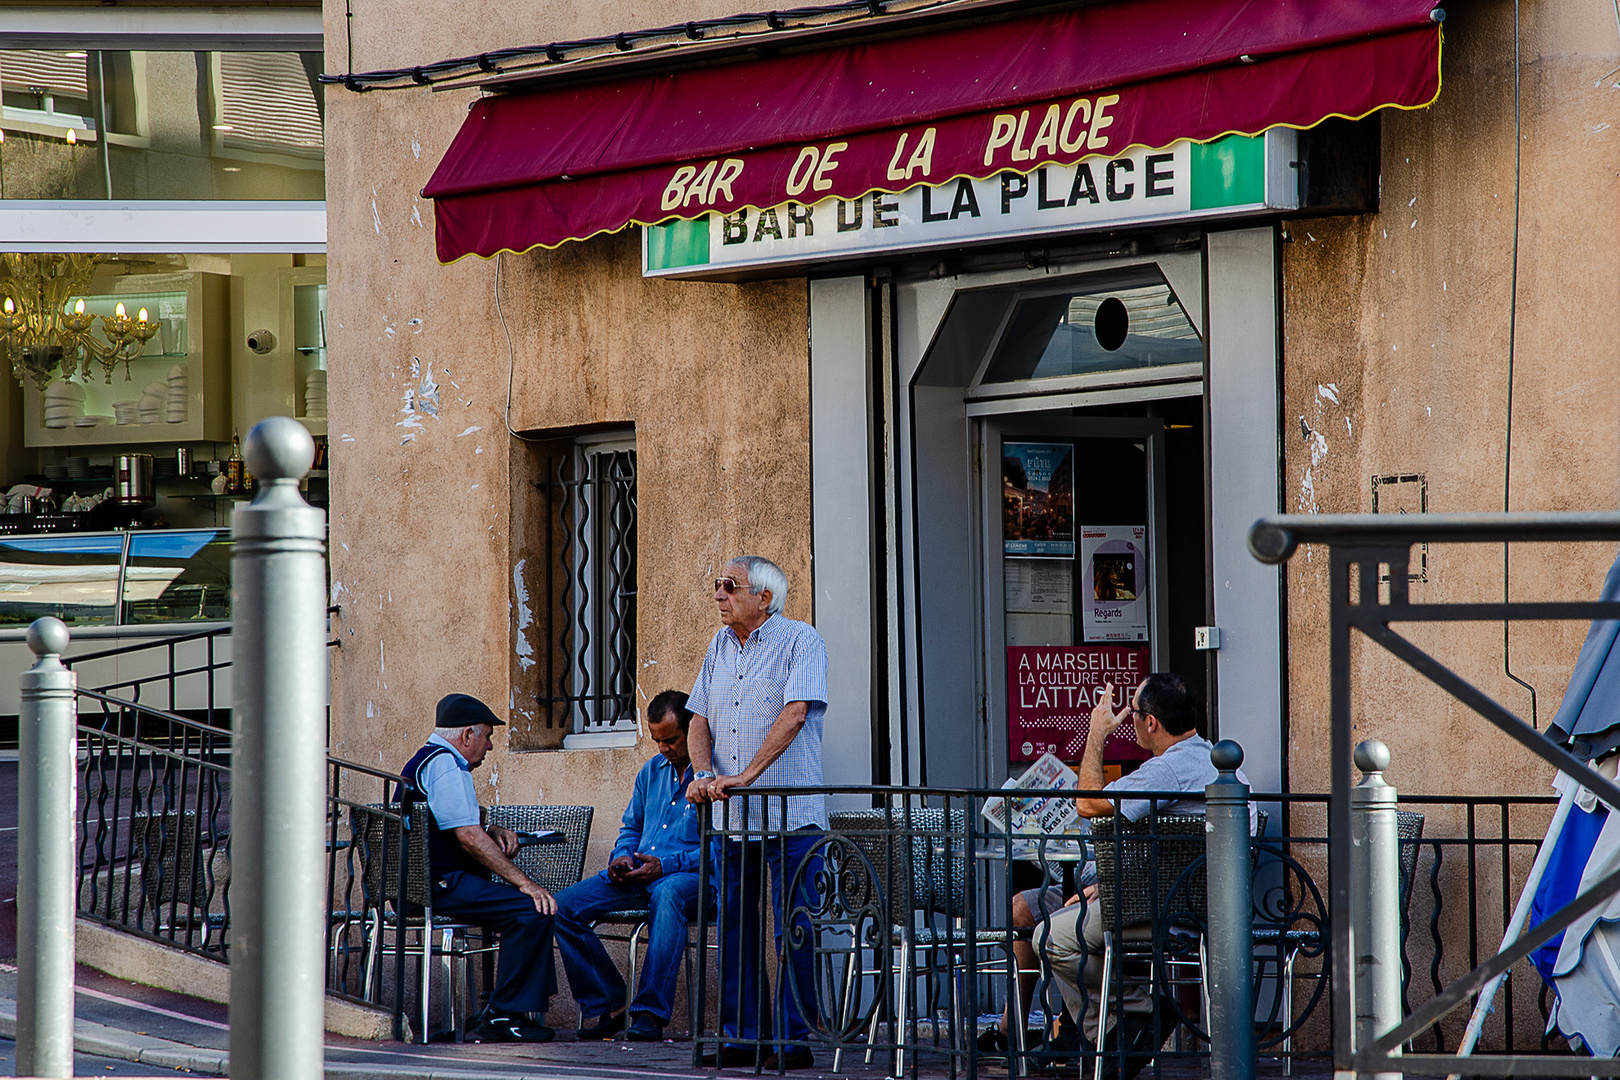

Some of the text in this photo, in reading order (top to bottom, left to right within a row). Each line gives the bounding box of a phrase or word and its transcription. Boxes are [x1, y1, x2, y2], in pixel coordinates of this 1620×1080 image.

[660, 158, 745, 211] BAR
[887, 127, 937, 181] LA
[984, 94, 1120, 167] PLACE
[723, 153, 1175, 246] BAR DE LA PLACE
[1094, 608, 1122, 619] Regards
[1019, 653, 1138, 670] A MARSEILLE
[1019, 671, 1139, 685] LA CULTURE C'EST
[1043, 818, 1061, 834] bras
[1060, 808, 1070, 818] de
